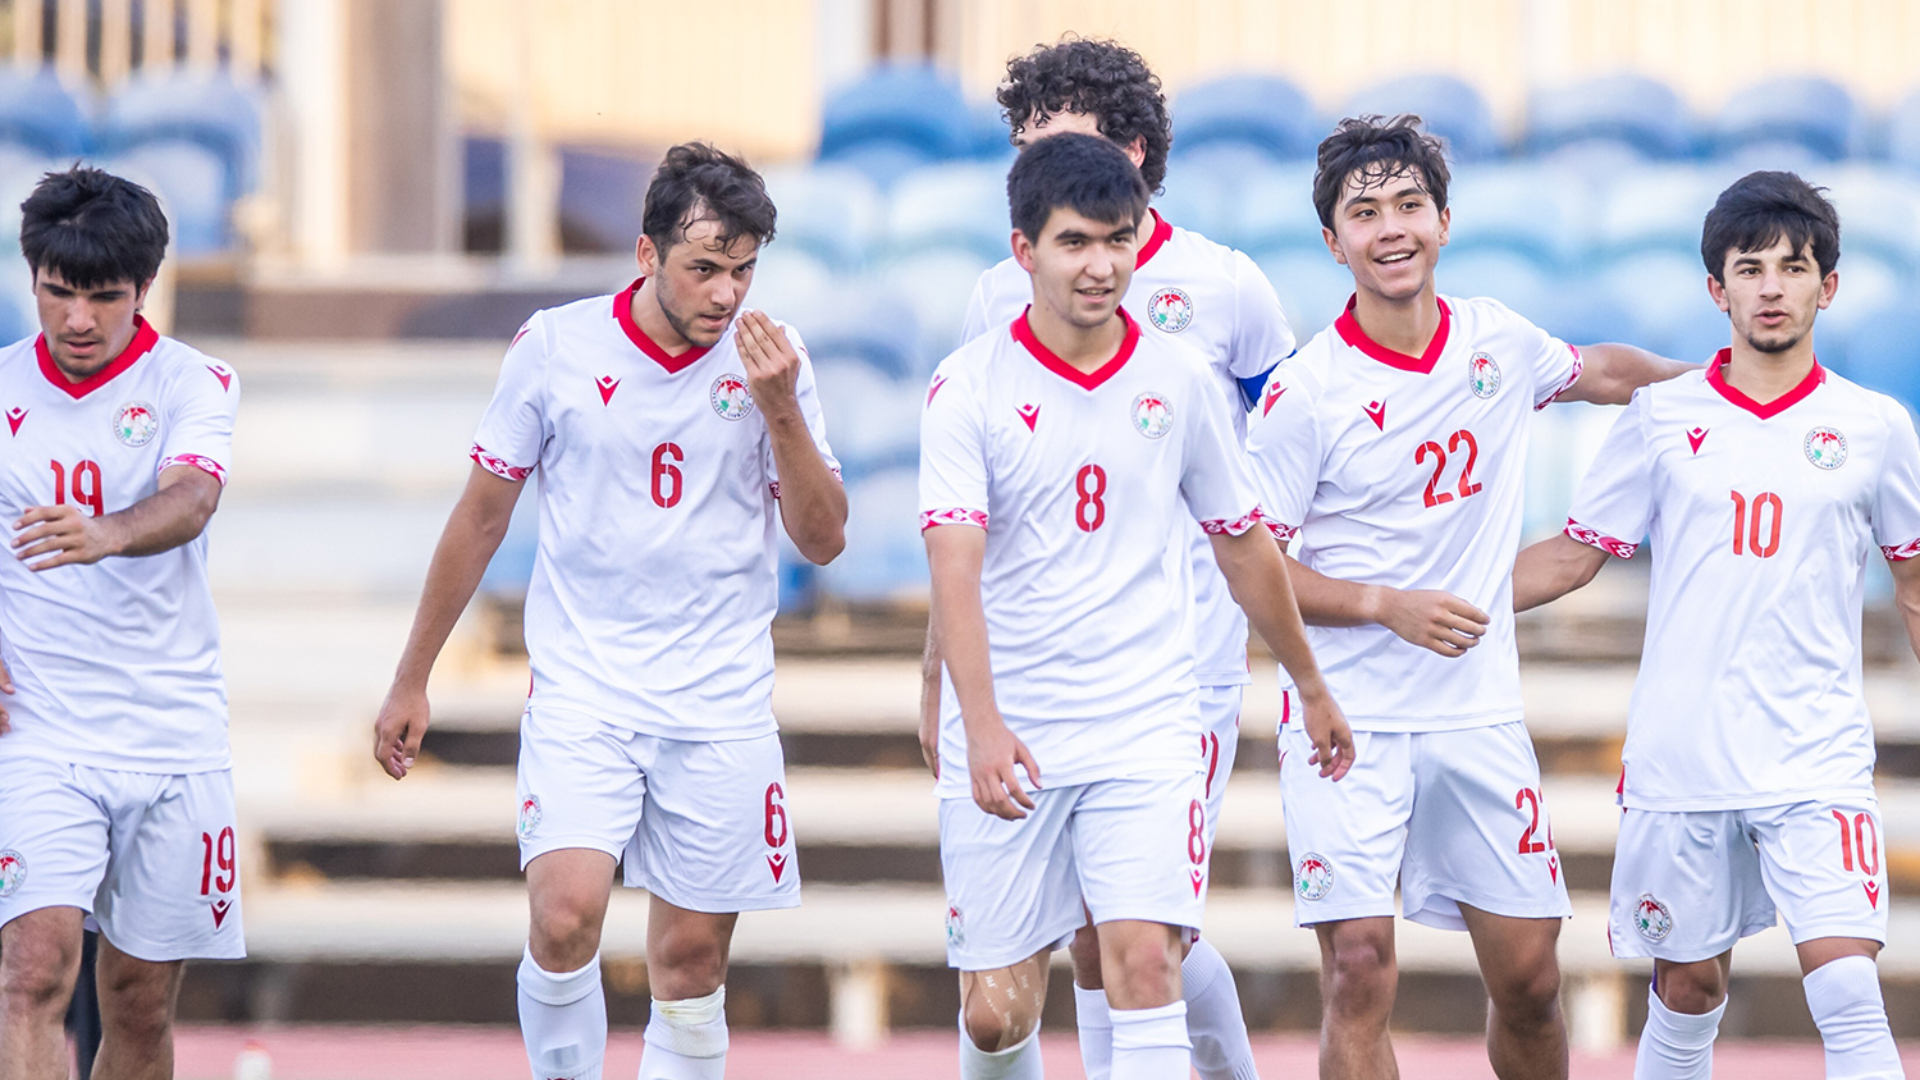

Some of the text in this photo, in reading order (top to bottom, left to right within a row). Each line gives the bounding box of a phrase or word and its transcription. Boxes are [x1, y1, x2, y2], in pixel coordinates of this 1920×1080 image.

[50, 459, 104, 517] 19
[651, 442, 684, 509] 6
[1075, 464, 1106, 532] 8
[1414, 429, 1483, 508] 22
[1730, 490, 1783, 559] 10
[764, 782, 788, 848] 6
[1187, 799, 1205, 866] 8
[1832, 809, 1880, 876] 10
[201, 826, 235, 896] 19
